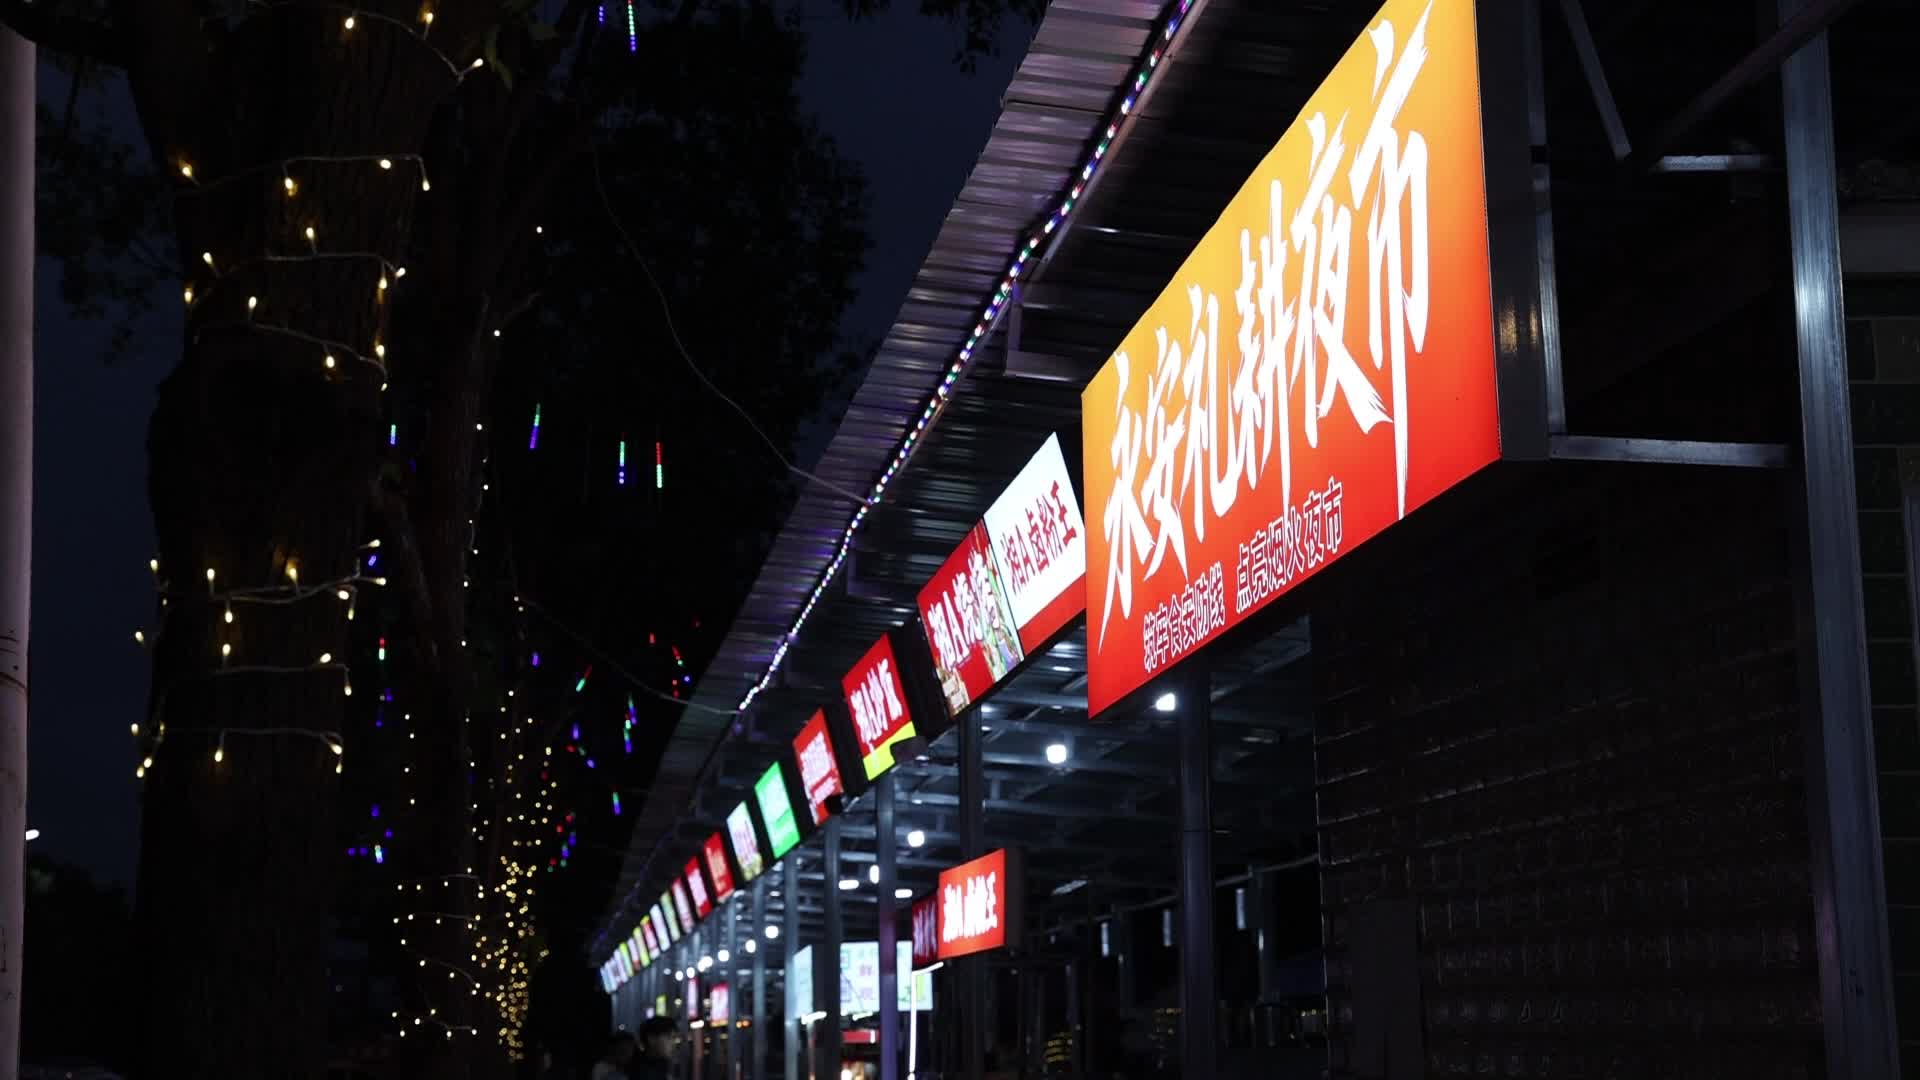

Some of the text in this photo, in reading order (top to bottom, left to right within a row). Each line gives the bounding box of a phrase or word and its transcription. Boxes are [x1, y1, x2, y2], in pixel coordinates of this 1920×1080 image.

[1098, 0, 1431, 651] 永安礼耕夜市
[1001, 480, 1077, 597] 湘A卤粉王
[1143, 475, 1343, 672] 筑牢食安防线 点亮烟火夜市
